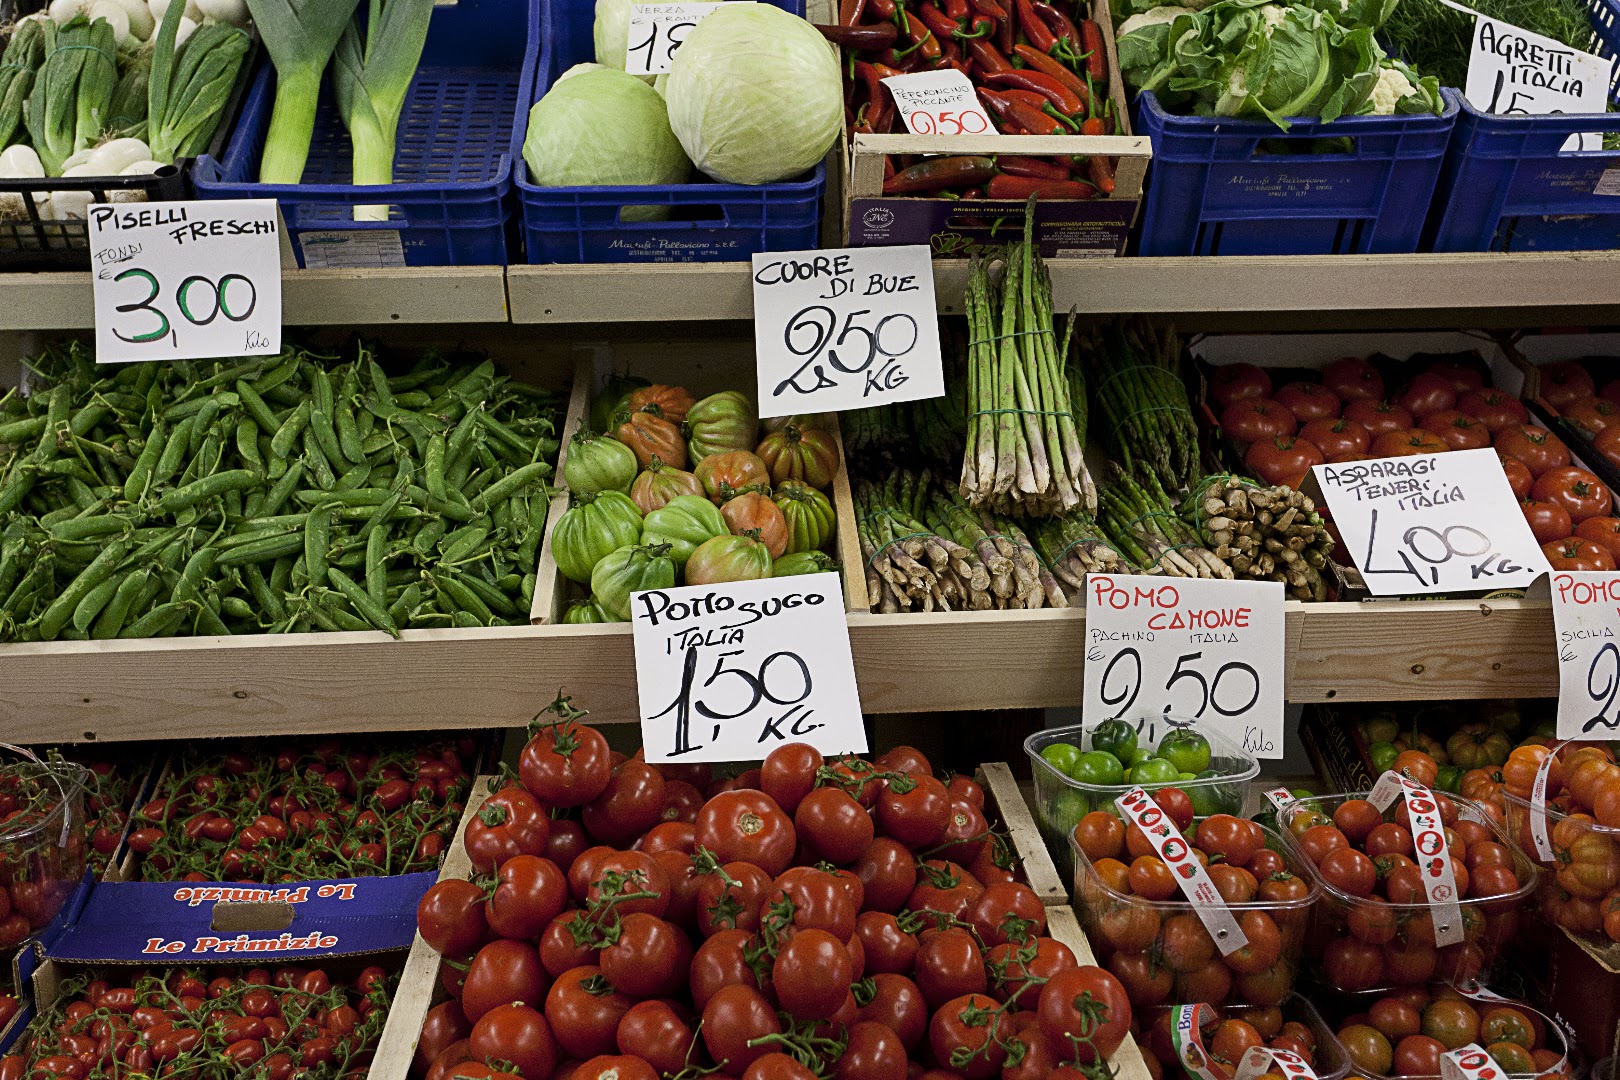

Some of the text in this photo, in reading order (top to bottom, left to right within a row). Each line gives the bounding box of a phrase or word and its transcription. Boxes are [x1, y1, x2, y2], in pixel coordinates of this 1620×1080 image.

[635, 6, 685, 14] VERZA
[1480, 22, 1574, 76] AGRETTI
[893, 85, 970, 100] PEPERONCINO
[1511, 65, 1583, 98] ITALIA
[909, 95, 964, 107] PICCANTE
[91, 206, 188, 232] PISELLI
[169, 220, 275, 245] FRESCHI
[94, 243, 143, 265] FONDI
[755, 255, 854, 285] CUORE
[820, 274, 920, 298] DI BUE
[112, 268, 257, 348] 3,00
[244, 330, 270, 351] Kilo
[863, 358, 910, 397] KG
[1324, 458, 1436, 487] ASPARAGI
[1346, 479, 1430, 501] TENERI
[1398, 483, 1466, 511] ITALIA
[1364, 508, 1492, 587] 4,00
[1090, 576, 1179, 609] POMO
[720, 593, 825, 629] SUGO
[1148, 608, 1252, 631] CAMONE
[667, 626, 744, 655] ITALIA
[1091, 628, 1239, 643] PACHINO ITALIA
[1561, 627, 1614, 642] SICILIA
[647, 646, 812, 757] 1,50
[1242, 725, 1274, 753] Kilo
[317, 884, 356, 899] Le
[142, 931, 338, 953] Le Primizie
